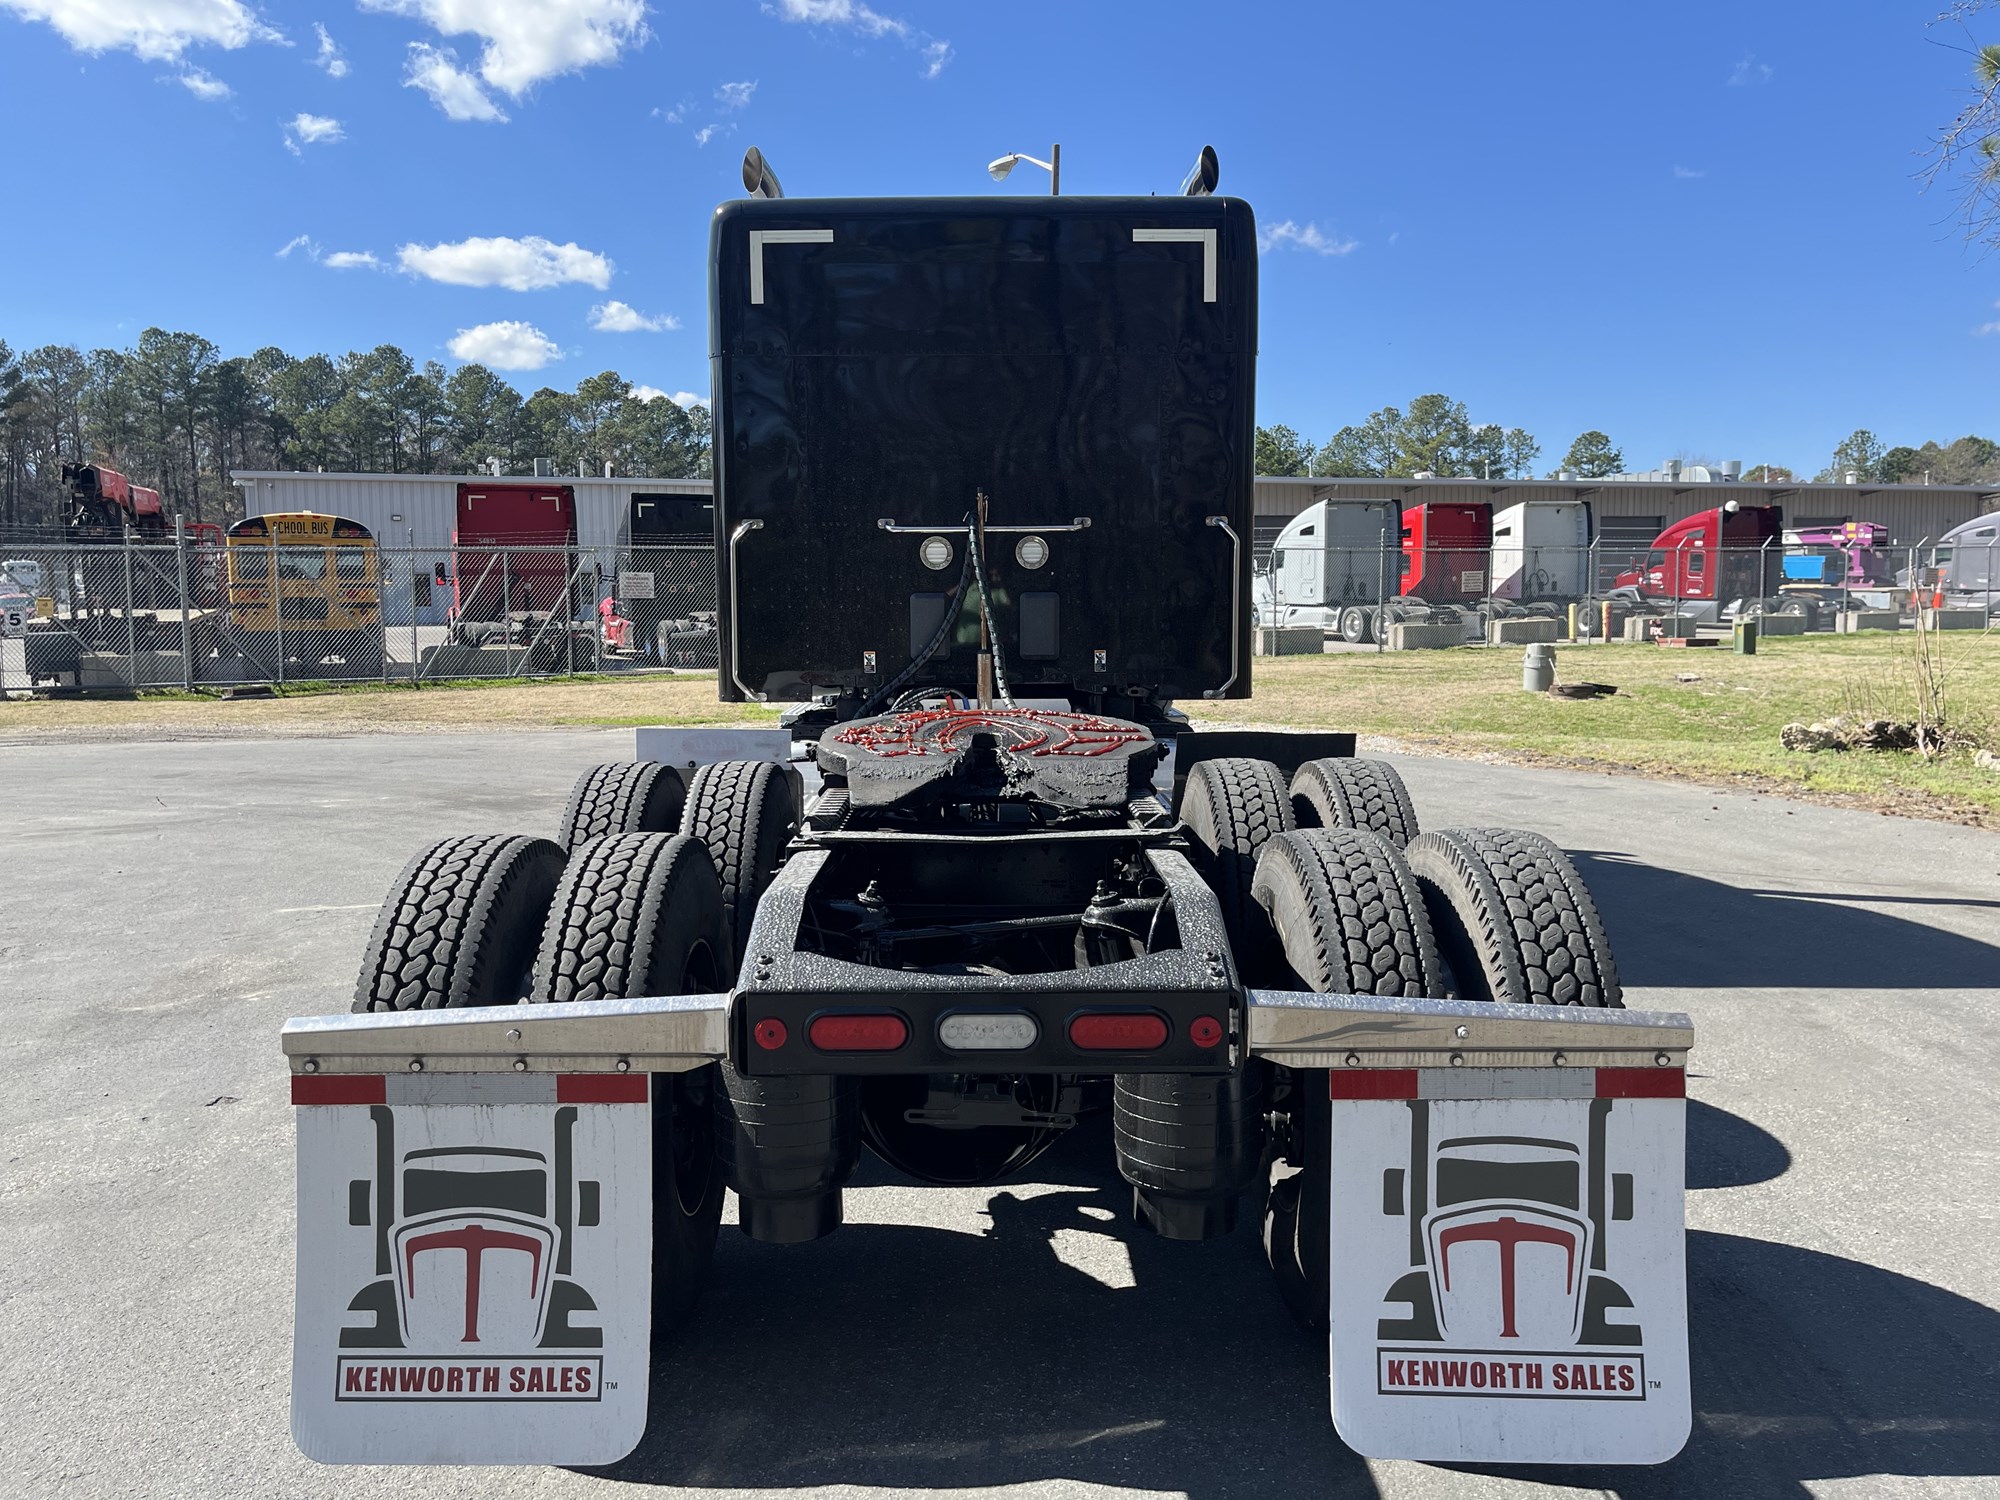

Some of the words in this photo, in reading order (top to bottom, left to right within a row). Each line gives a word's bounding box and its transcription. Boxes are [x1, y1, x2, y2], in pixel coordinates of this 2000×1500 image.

[312, 522, 328, 534] BUS
[9, 613, 21, 626] 5
[345, 1366, 500, 1392] KENWORTH
[509, 1366, 591, 1392] SALES
[1388, 1360, 1543, 1389] KENWORTH
[1552, 1363, 1635, 1391] SALES
